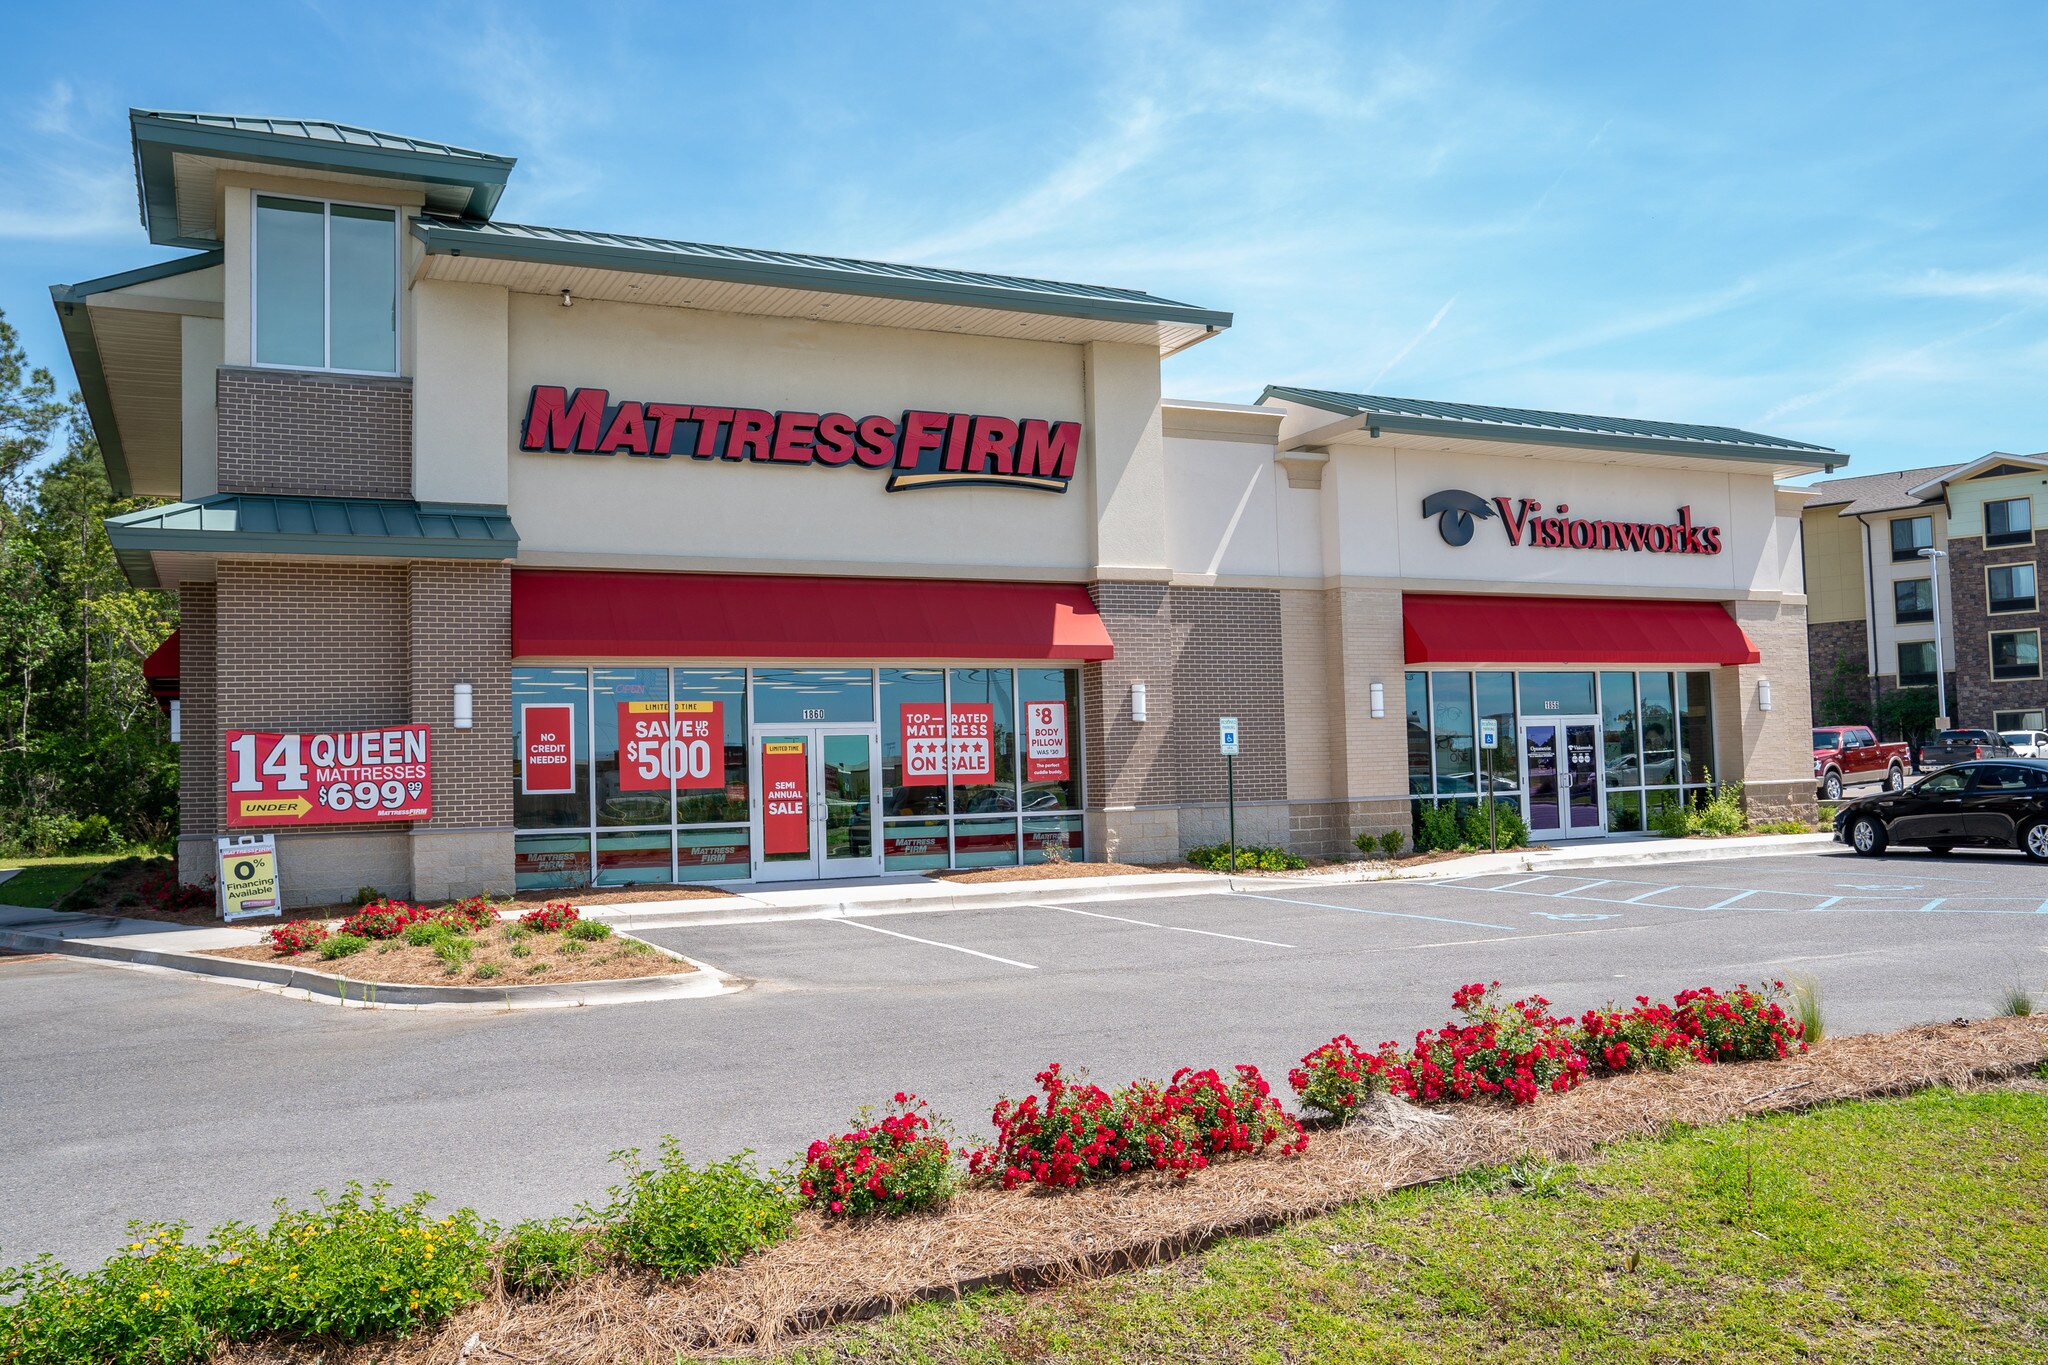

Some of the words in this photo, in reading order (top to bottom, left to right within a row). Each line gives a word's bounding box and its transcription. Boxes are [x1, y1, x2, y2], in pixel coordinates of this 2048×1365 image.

[1491, 496, 1722, 555] Visionworks
[804, 709, 824, 719] 1860
[1035, 707, 1052, 725] $8
[635, 720, 693, 738] SAVE
[695, 720, 709, 729] UP
[695, 728, 709, 737] TO
[1035, 728, 1059, 737] BODY
[540, 733, 556, 742] NO
[1031, 738, 1063, 747] PILLOW
[309, 729, 427, 768] QUEEN
[530, 744, 566, 753] CREDIT
[230, 733, 309, 792] 14
[529, 755, 567, 764] NEEDED
[627, 739, 711, 780] $500
[911, 757, 937, 771] ON
[941, 756, 986, 771] SALE
[316, 765, 426, 782] MATTRESSES
[775, 781, 796, 790] SEMI
[768, 790, 803, 799] ANNUAL
[246, 803, 298, 812] UNDER
[768, 802, 803, 815] SALE
[896, 838, 936, 847] MATTRESS
[691, 846, 735, 855] MATTRESS
[904, 845, 927, 853] FIRM
[527, 853, 575, 862] MATTRESS
[701, 854, 727, 863] FIRM
[538, 861, 565, 869] FIRM
[226, 878, 275, 891] Financing
[228, 886, 273, 899] Available
